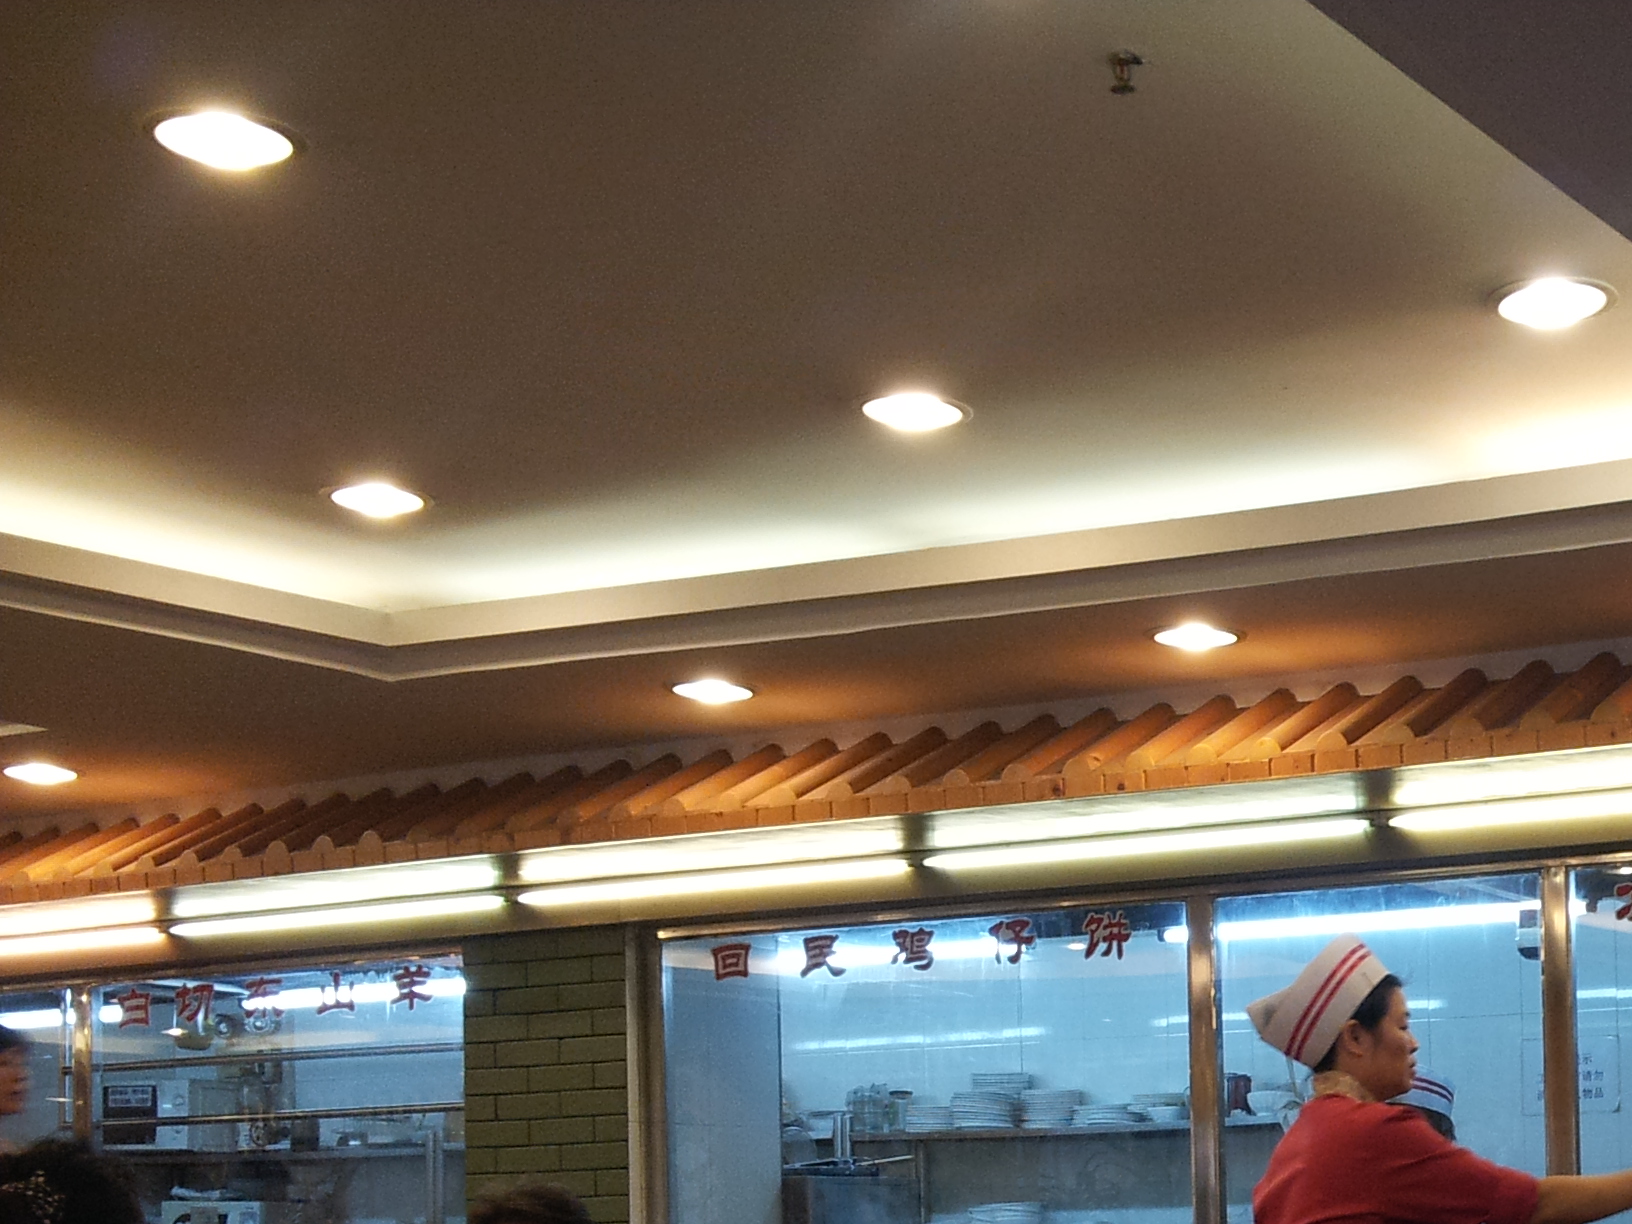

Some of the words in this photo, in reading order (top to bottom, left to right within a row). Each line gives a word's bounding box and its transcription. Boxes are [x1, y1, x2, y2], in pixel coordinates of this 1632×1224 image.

[711, 909, 1133, 981] 回民鸡仔饼
